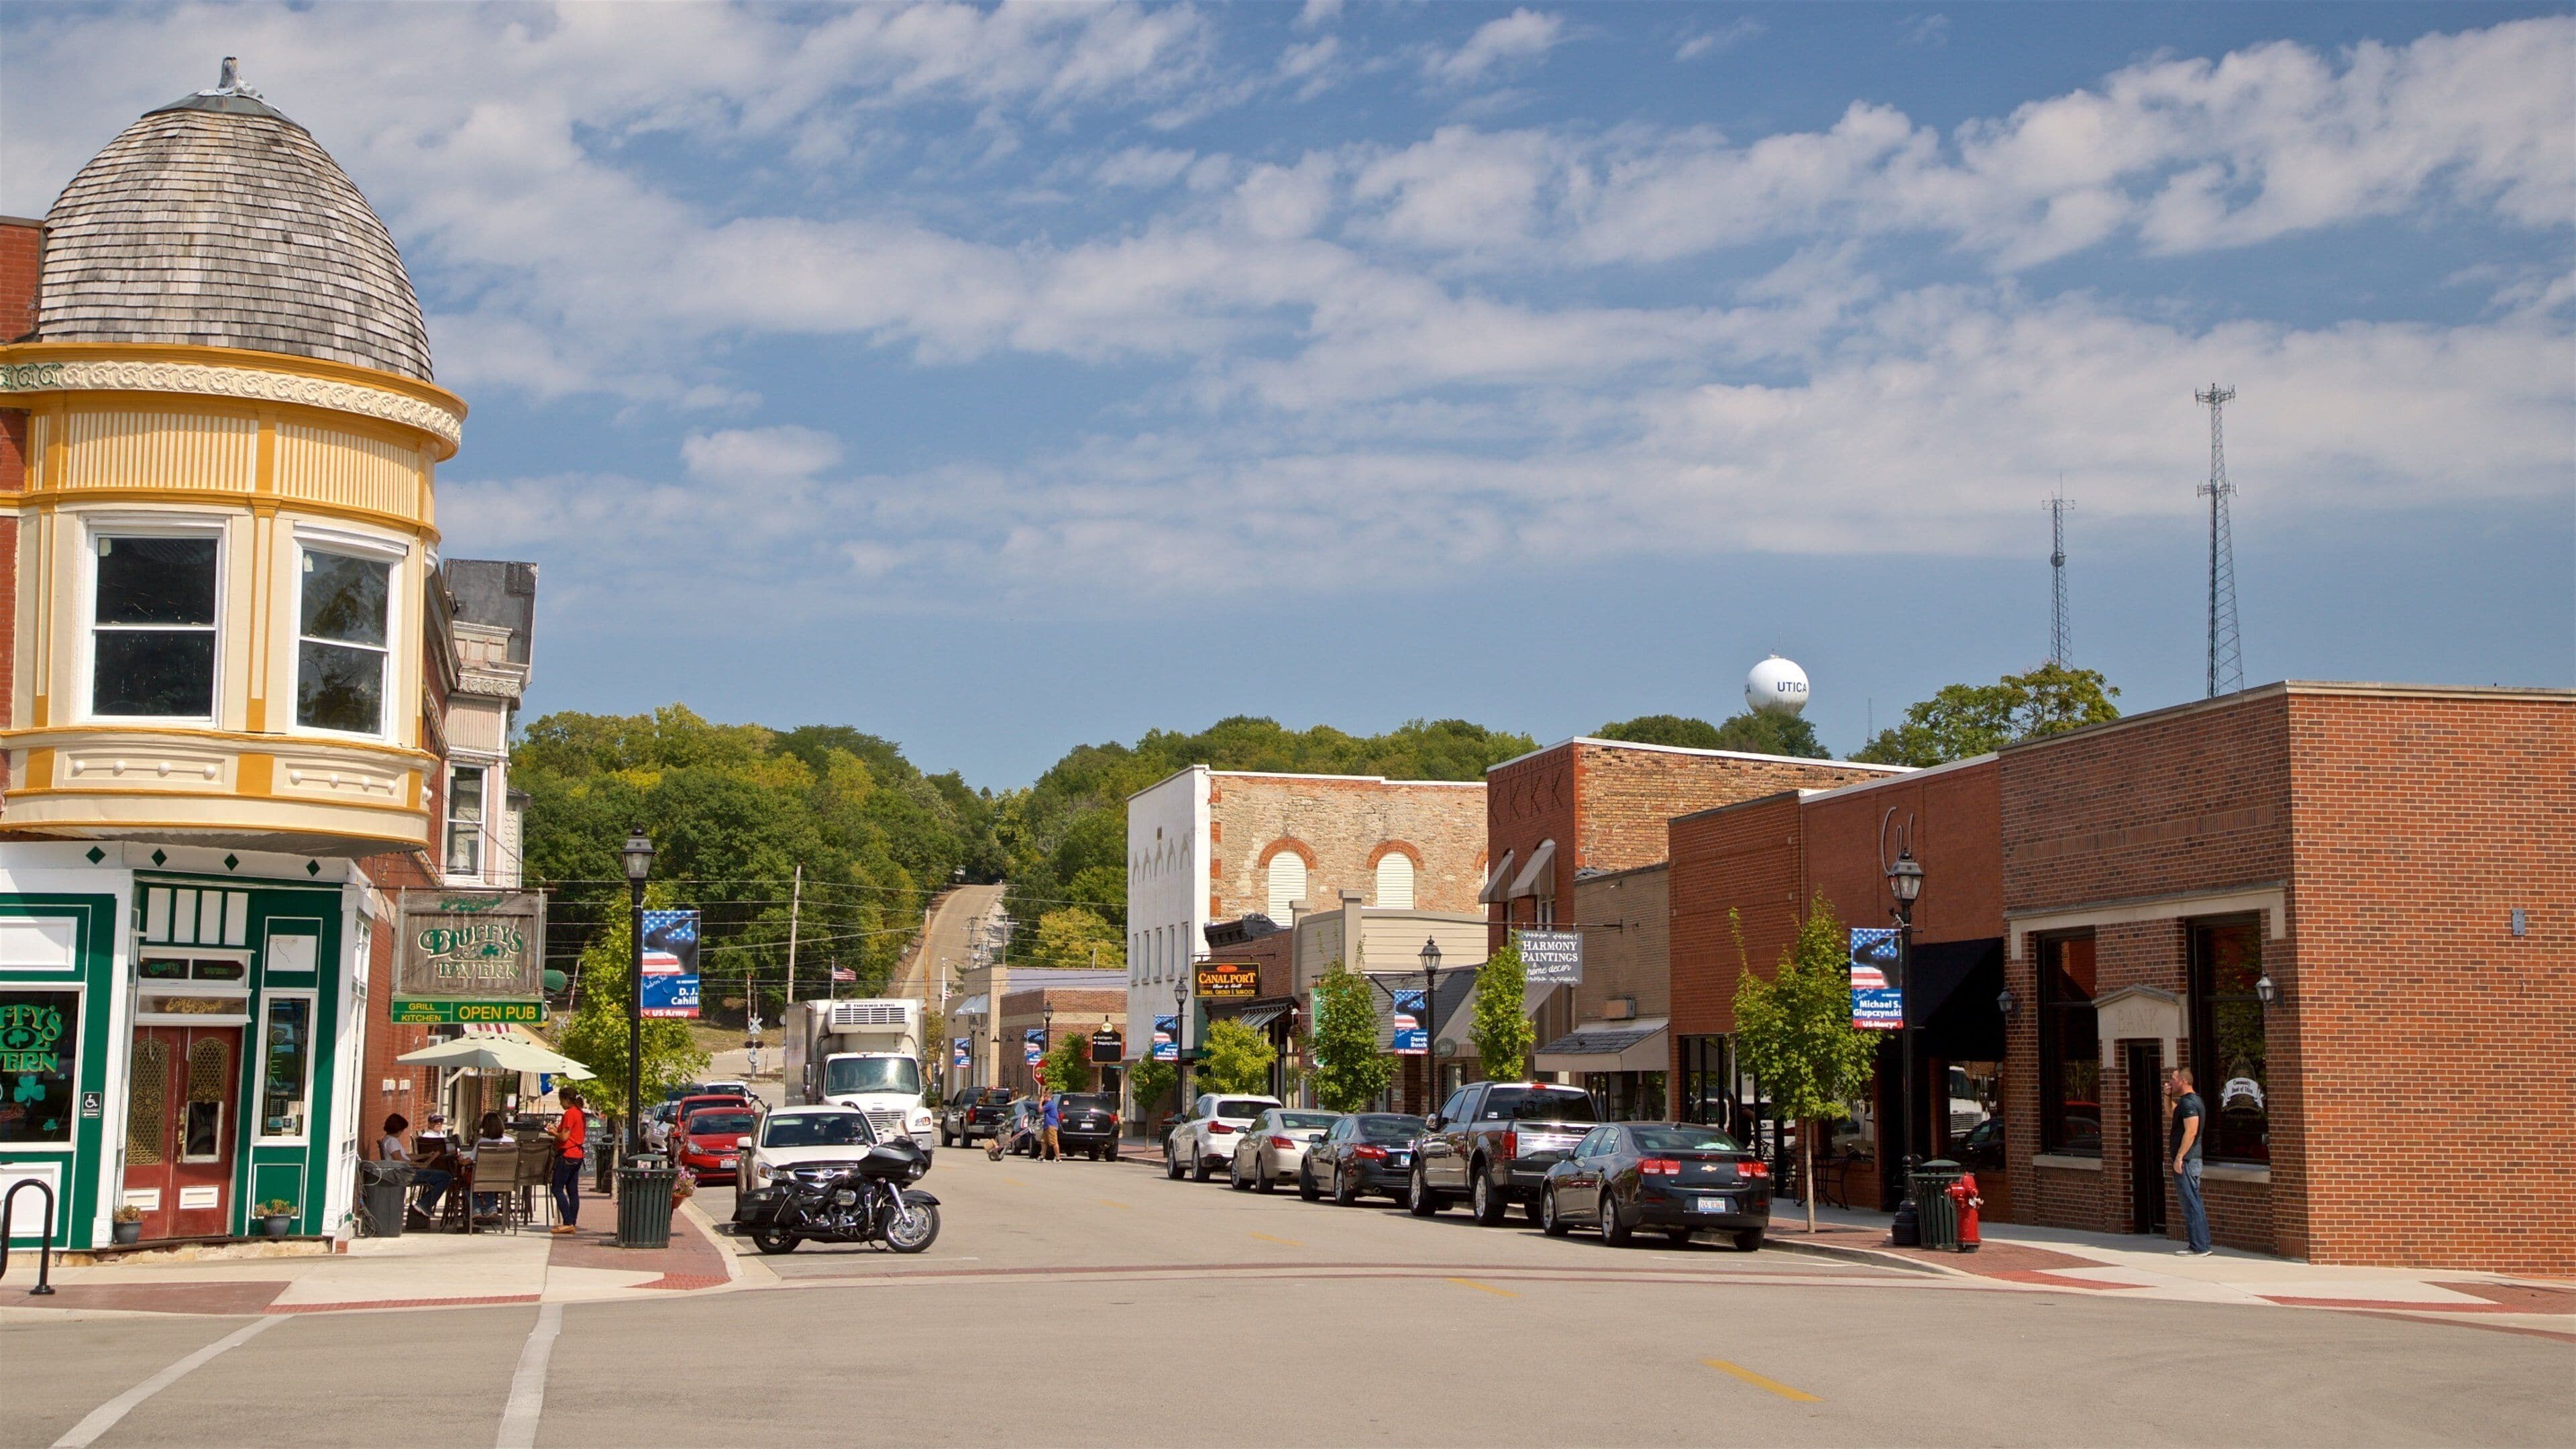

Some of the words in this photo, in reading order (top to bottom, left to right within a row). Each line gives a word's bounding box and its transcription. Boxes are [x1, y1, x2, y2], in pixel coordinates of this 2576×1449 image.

[1777, 682, 1807, 693] UTICA
[417, 923, 523, 959] DUFFY'S
[1522, 941, 1577, 951] HARMONY
[1521, 952, 1578, 962] PAINTINGS
[435, 961, 520, 979] TAVERN
[1527, 967, 1547, 975] home
[1548, 964, 1572, 973] decor
[1198, 973, 1230, 984] CANAL
[1230, 972, 1256, 983] PORT
[679, 987, 689, 996] D.
[690, 987, 698, 996] J.
[671, 996, 698, 1005] Cahill
[1860, 1000, 1892, 1008] Michael
[1893, 1000, 1901, 1008] S.
[459, 1006, 501, 1020] OPEN
[506, 1006, 536, 1020] PUB
[665, 1009, 689, 1018] Army
[1853, 1008, 1902, 1018] Glupczynski
[2117, 1008, 2159, 1031] BANK
